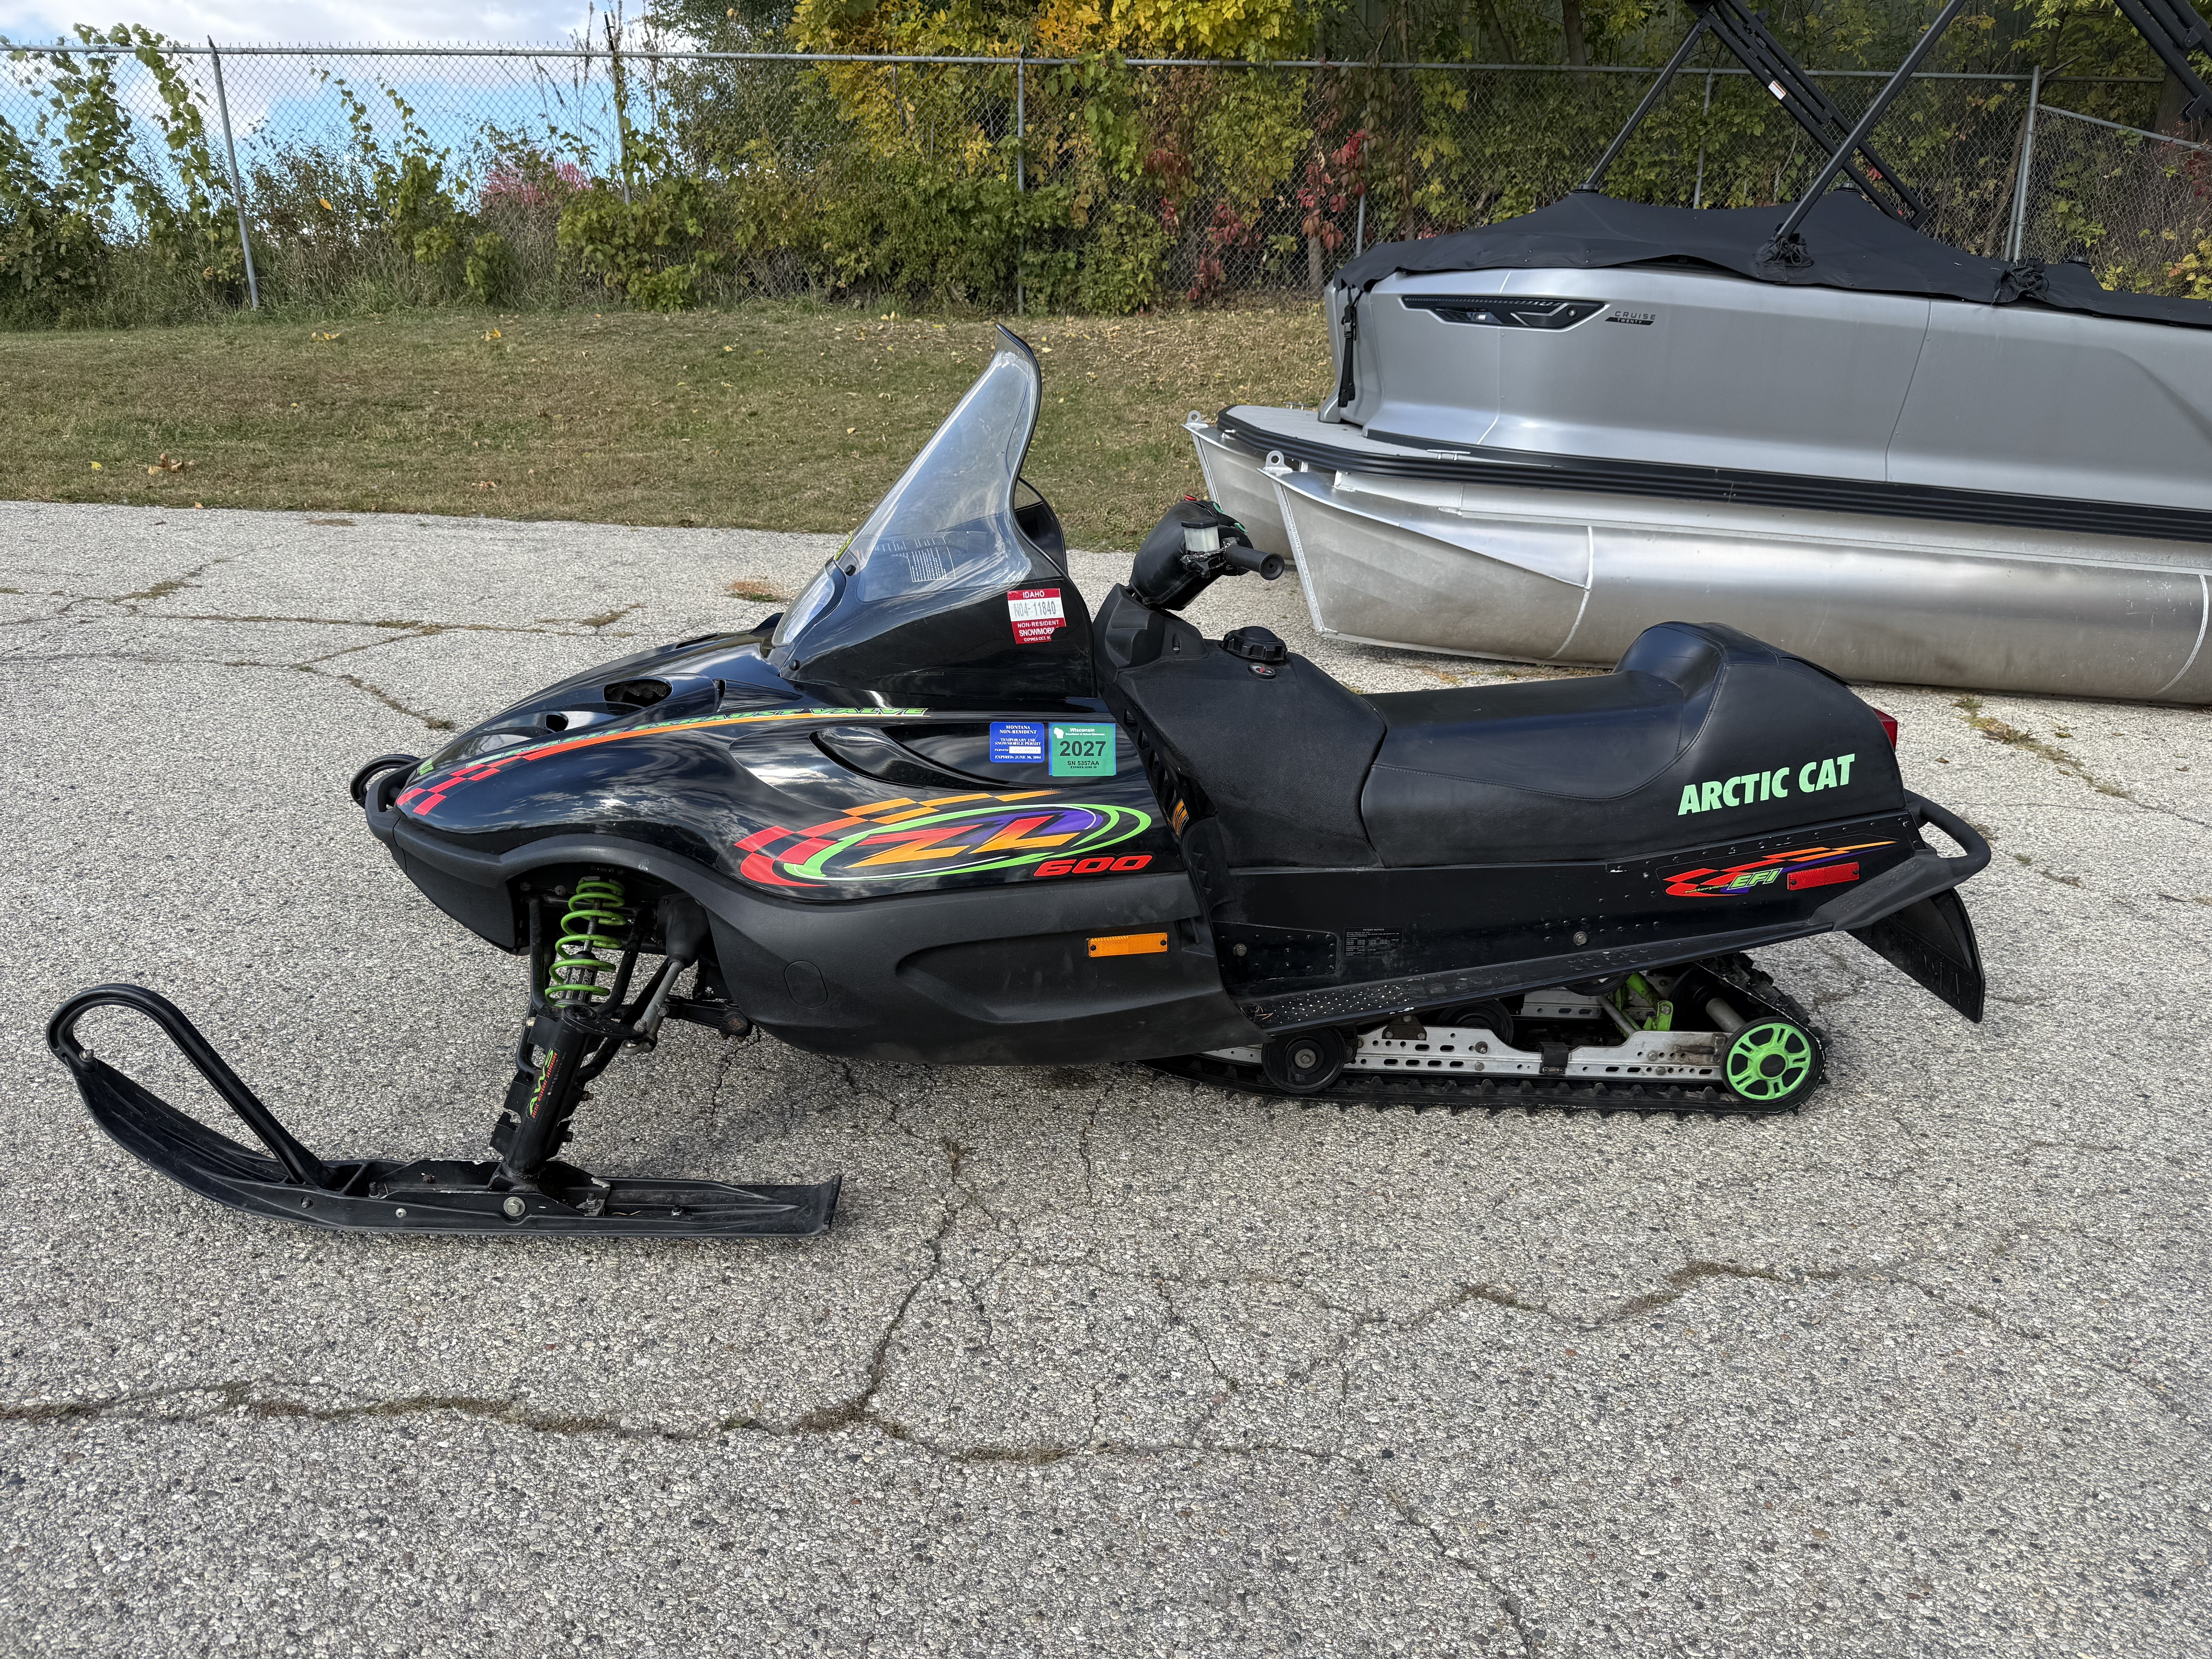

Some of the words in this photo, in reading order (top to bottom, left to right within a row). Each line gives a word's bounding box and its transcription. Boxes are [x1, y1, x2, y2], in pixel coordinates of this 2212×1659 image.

[1615, 311, 1656, 320] CRUISE
[630, 709, 804, 732] EXHAUST
[1060, 740, 1106, 756] 2027
[1678, 767, 1790, 816] ARCTIC
[1798, 753, 1855, 793] CAT
[846, 815, 1081, 869] ZL
[1034, 854, 1153, 877] 600
[1728, 868, 1782, 890] EFI
[530, 1048, 553, 1115] AWS
